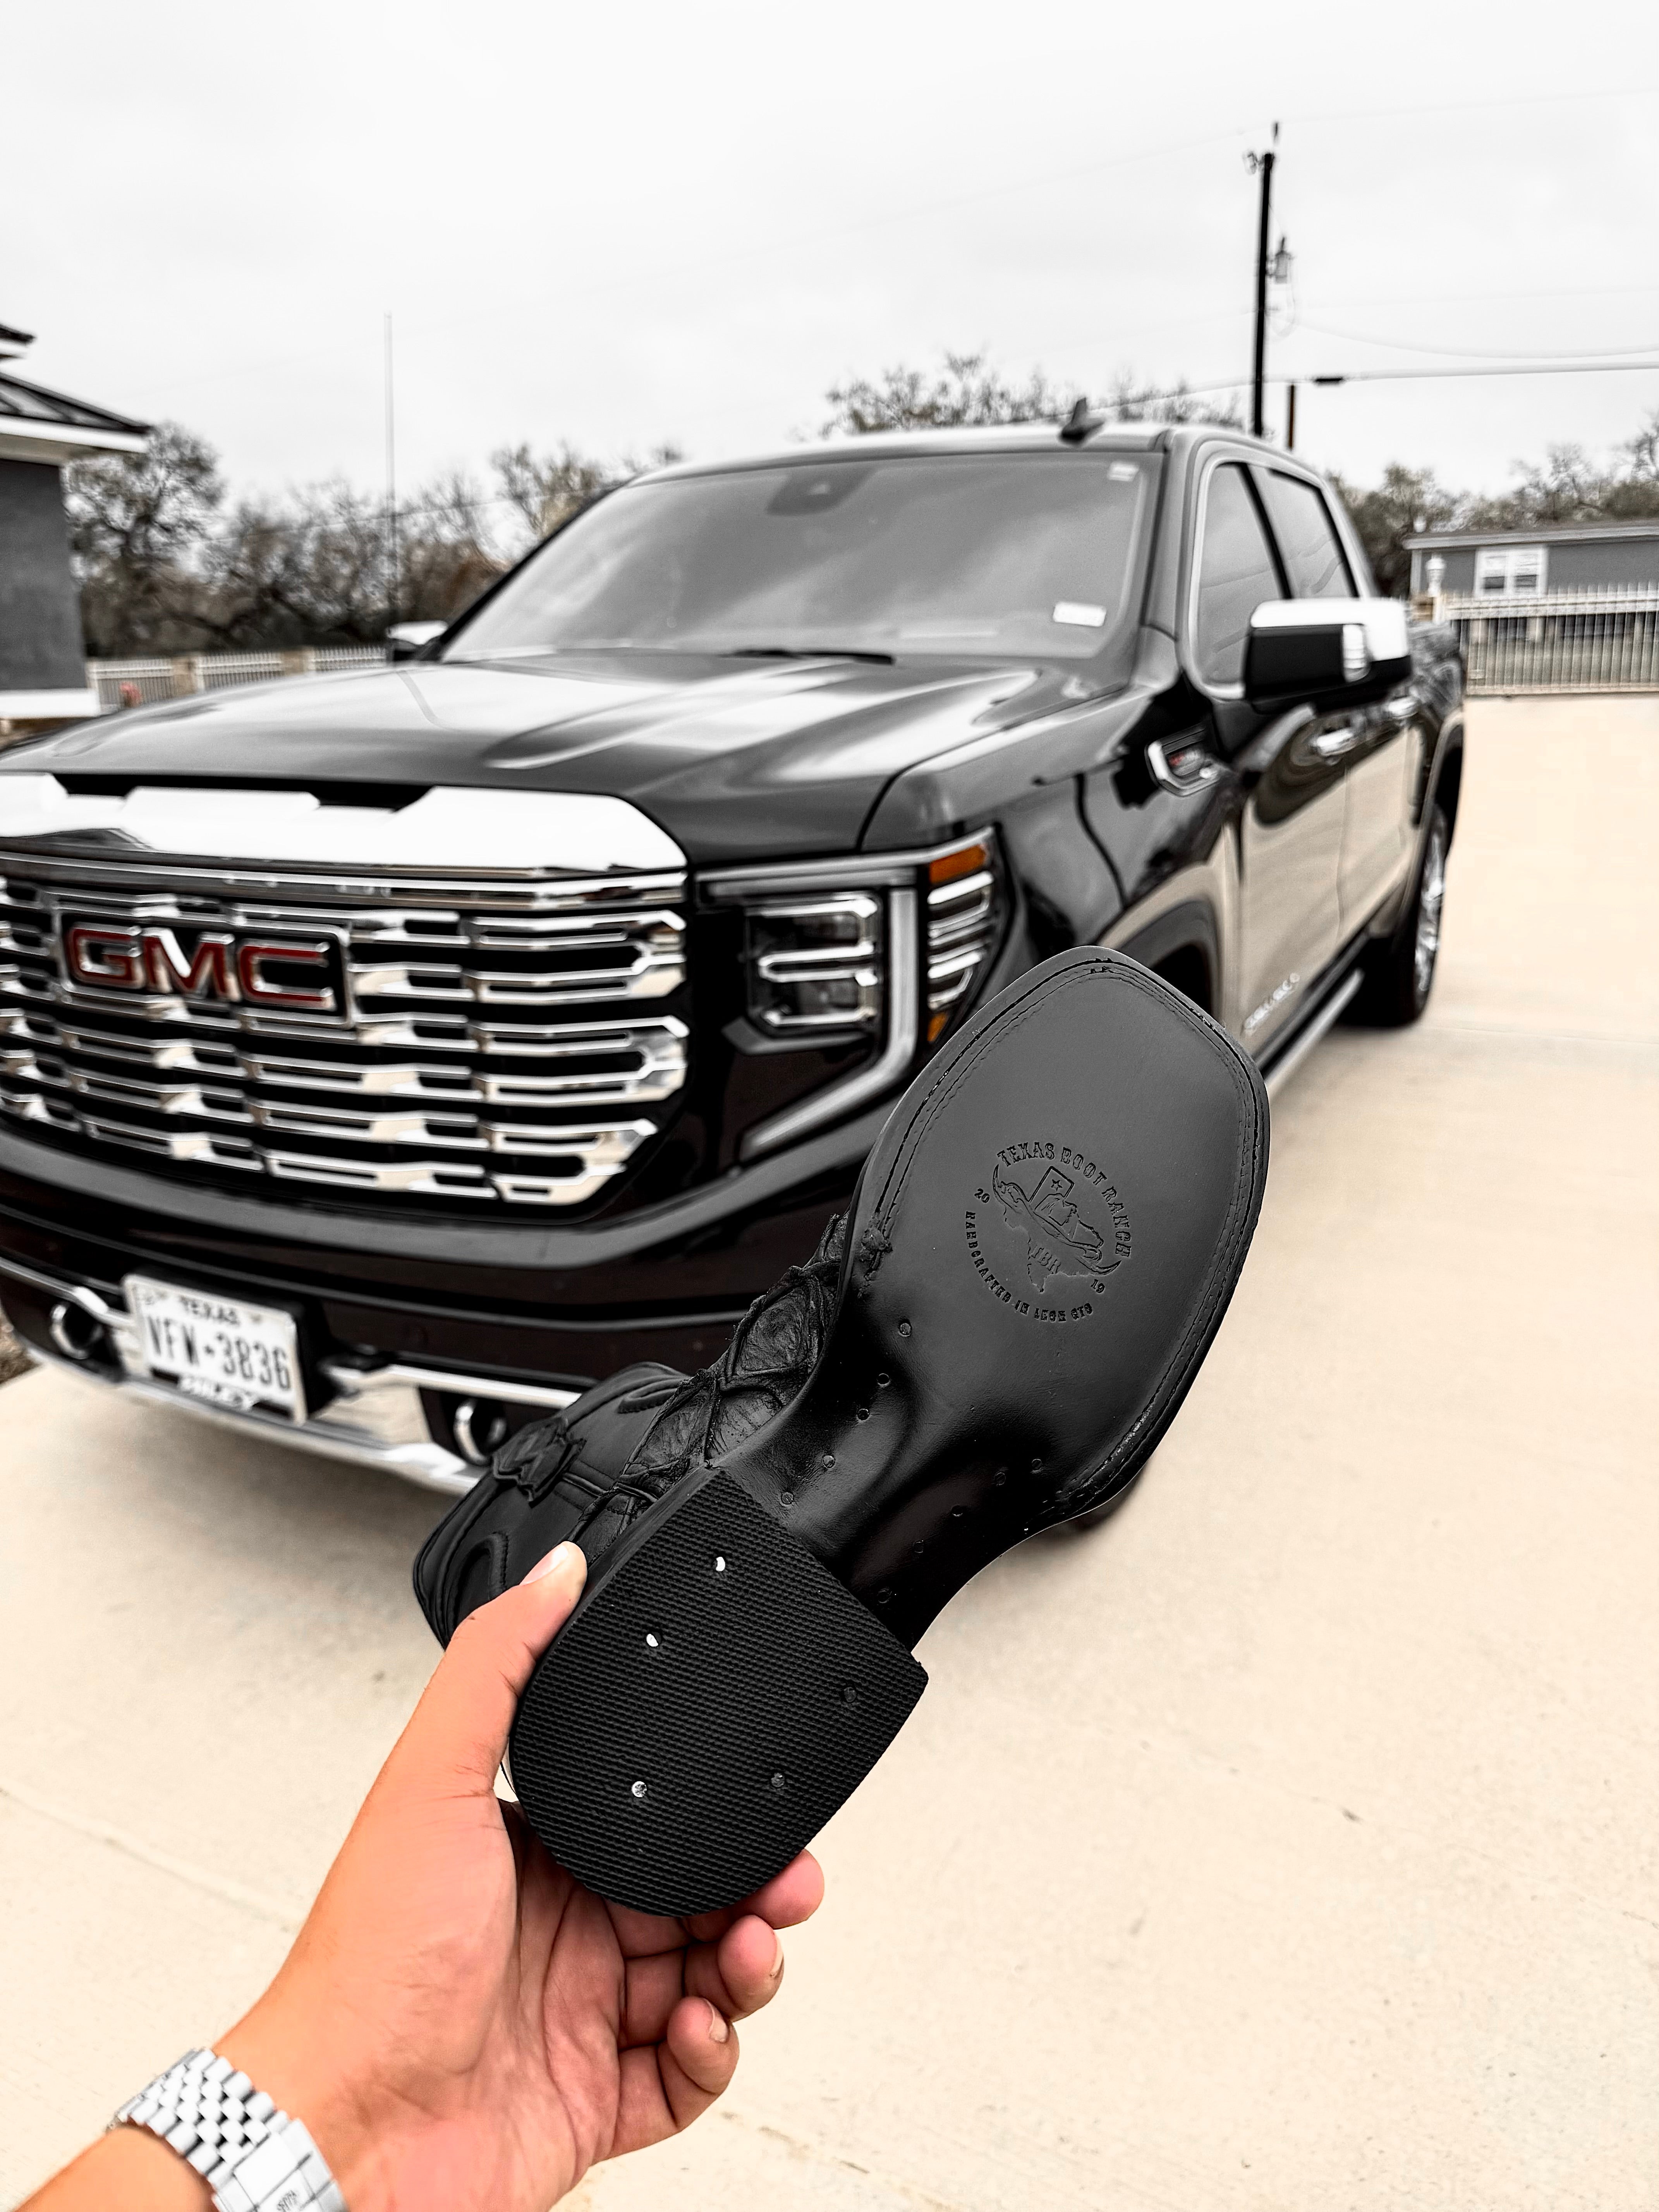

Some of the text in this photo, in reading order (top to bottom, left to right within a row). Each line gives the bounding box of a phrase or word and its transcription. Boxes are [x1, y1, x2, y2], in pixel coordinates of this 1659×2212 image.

[67, 923, 336, 1010] GMC
[974, 1188, 990, 1203] 20
[996, 1142, 1132, 1257] TEXAS BOOT RANCH
[965, 1211, 1012, 1303] HANDCRAFTED
[1014, 1300, 1030, 1315] IN
[1034, 1308, 1066, 1322] LEON
[1090, 1279, 1105, 1293] 19
[179, 1295, 240, 1325] TEXAS
